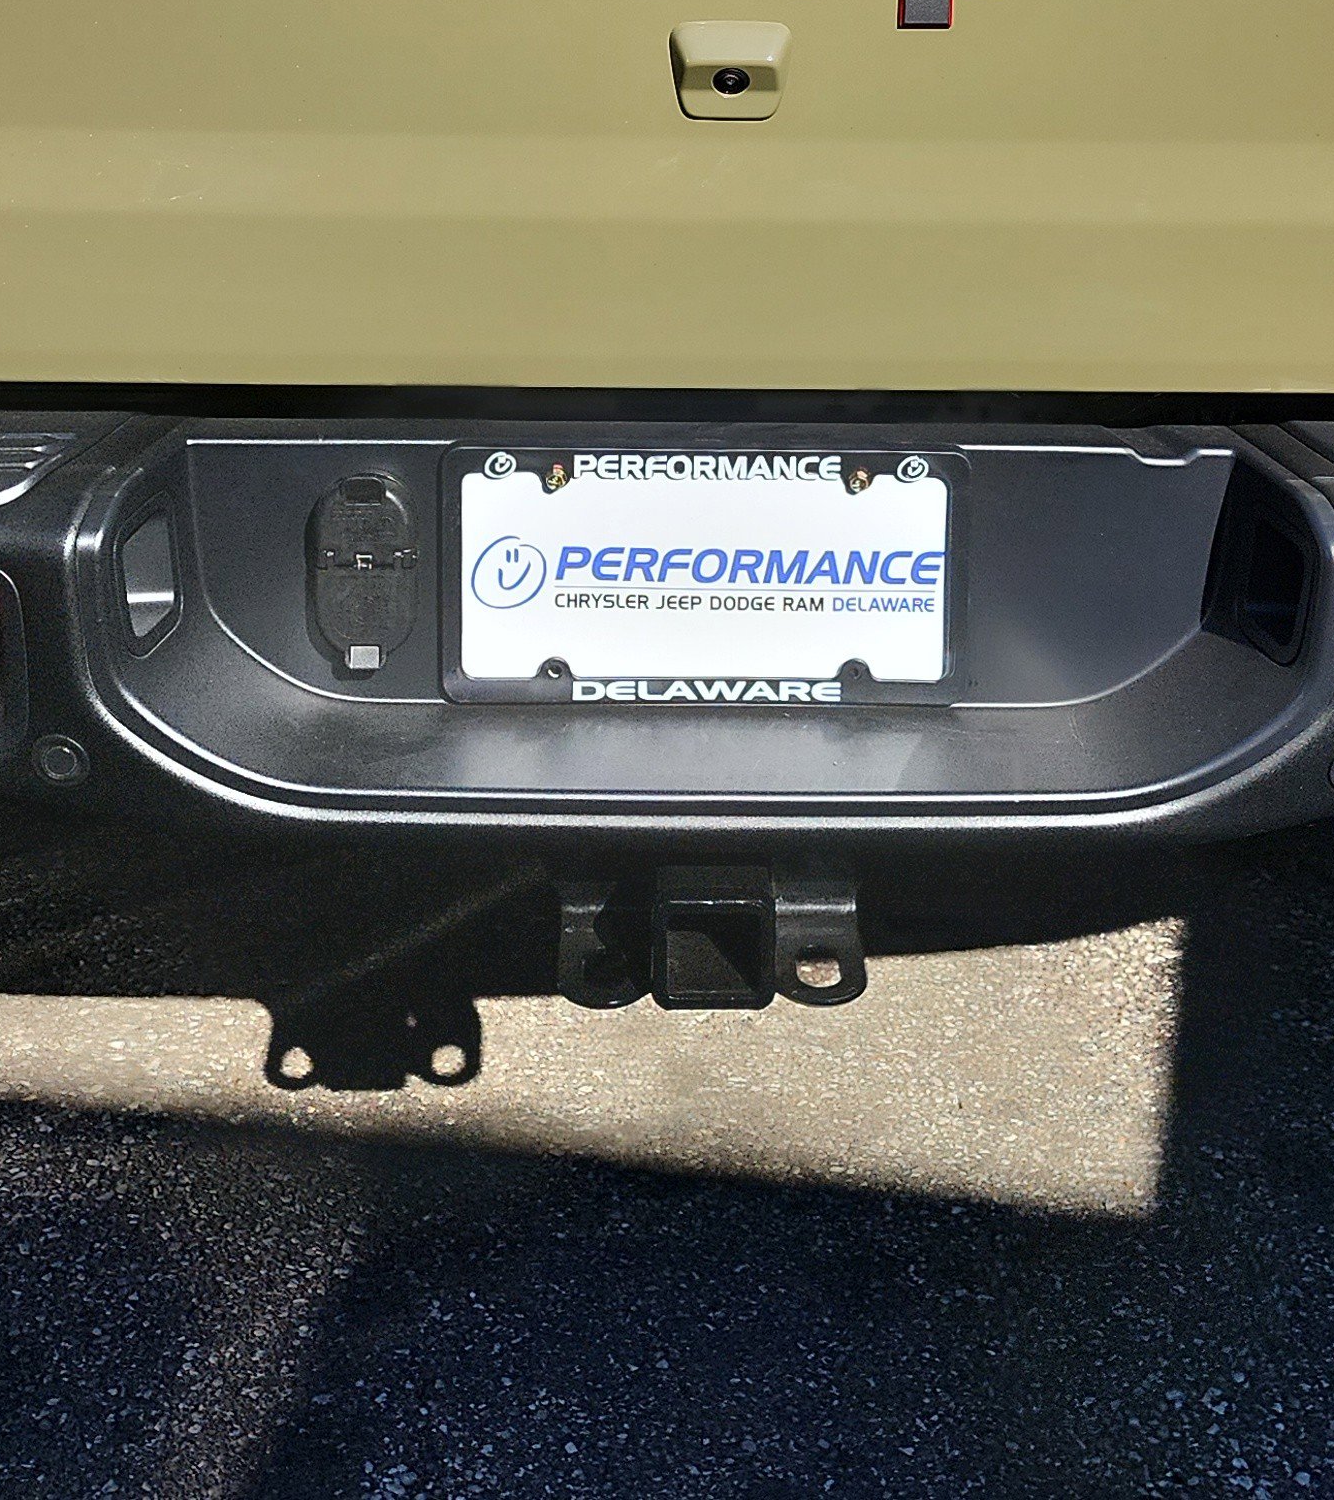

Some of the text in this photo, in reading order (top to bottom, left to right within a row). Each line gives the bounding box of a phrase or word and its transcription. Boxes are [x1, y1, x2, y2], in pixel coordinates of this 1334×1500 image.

[573, 454, 842, 482] PERFORMANCE
[554, 546, 947, 585] PERFORMANCE
[554, 593, 935, 613] CHRYSLER JEEP DODGE RAM DELAWARE
[572, 679, 842, 702] DELAWARE
